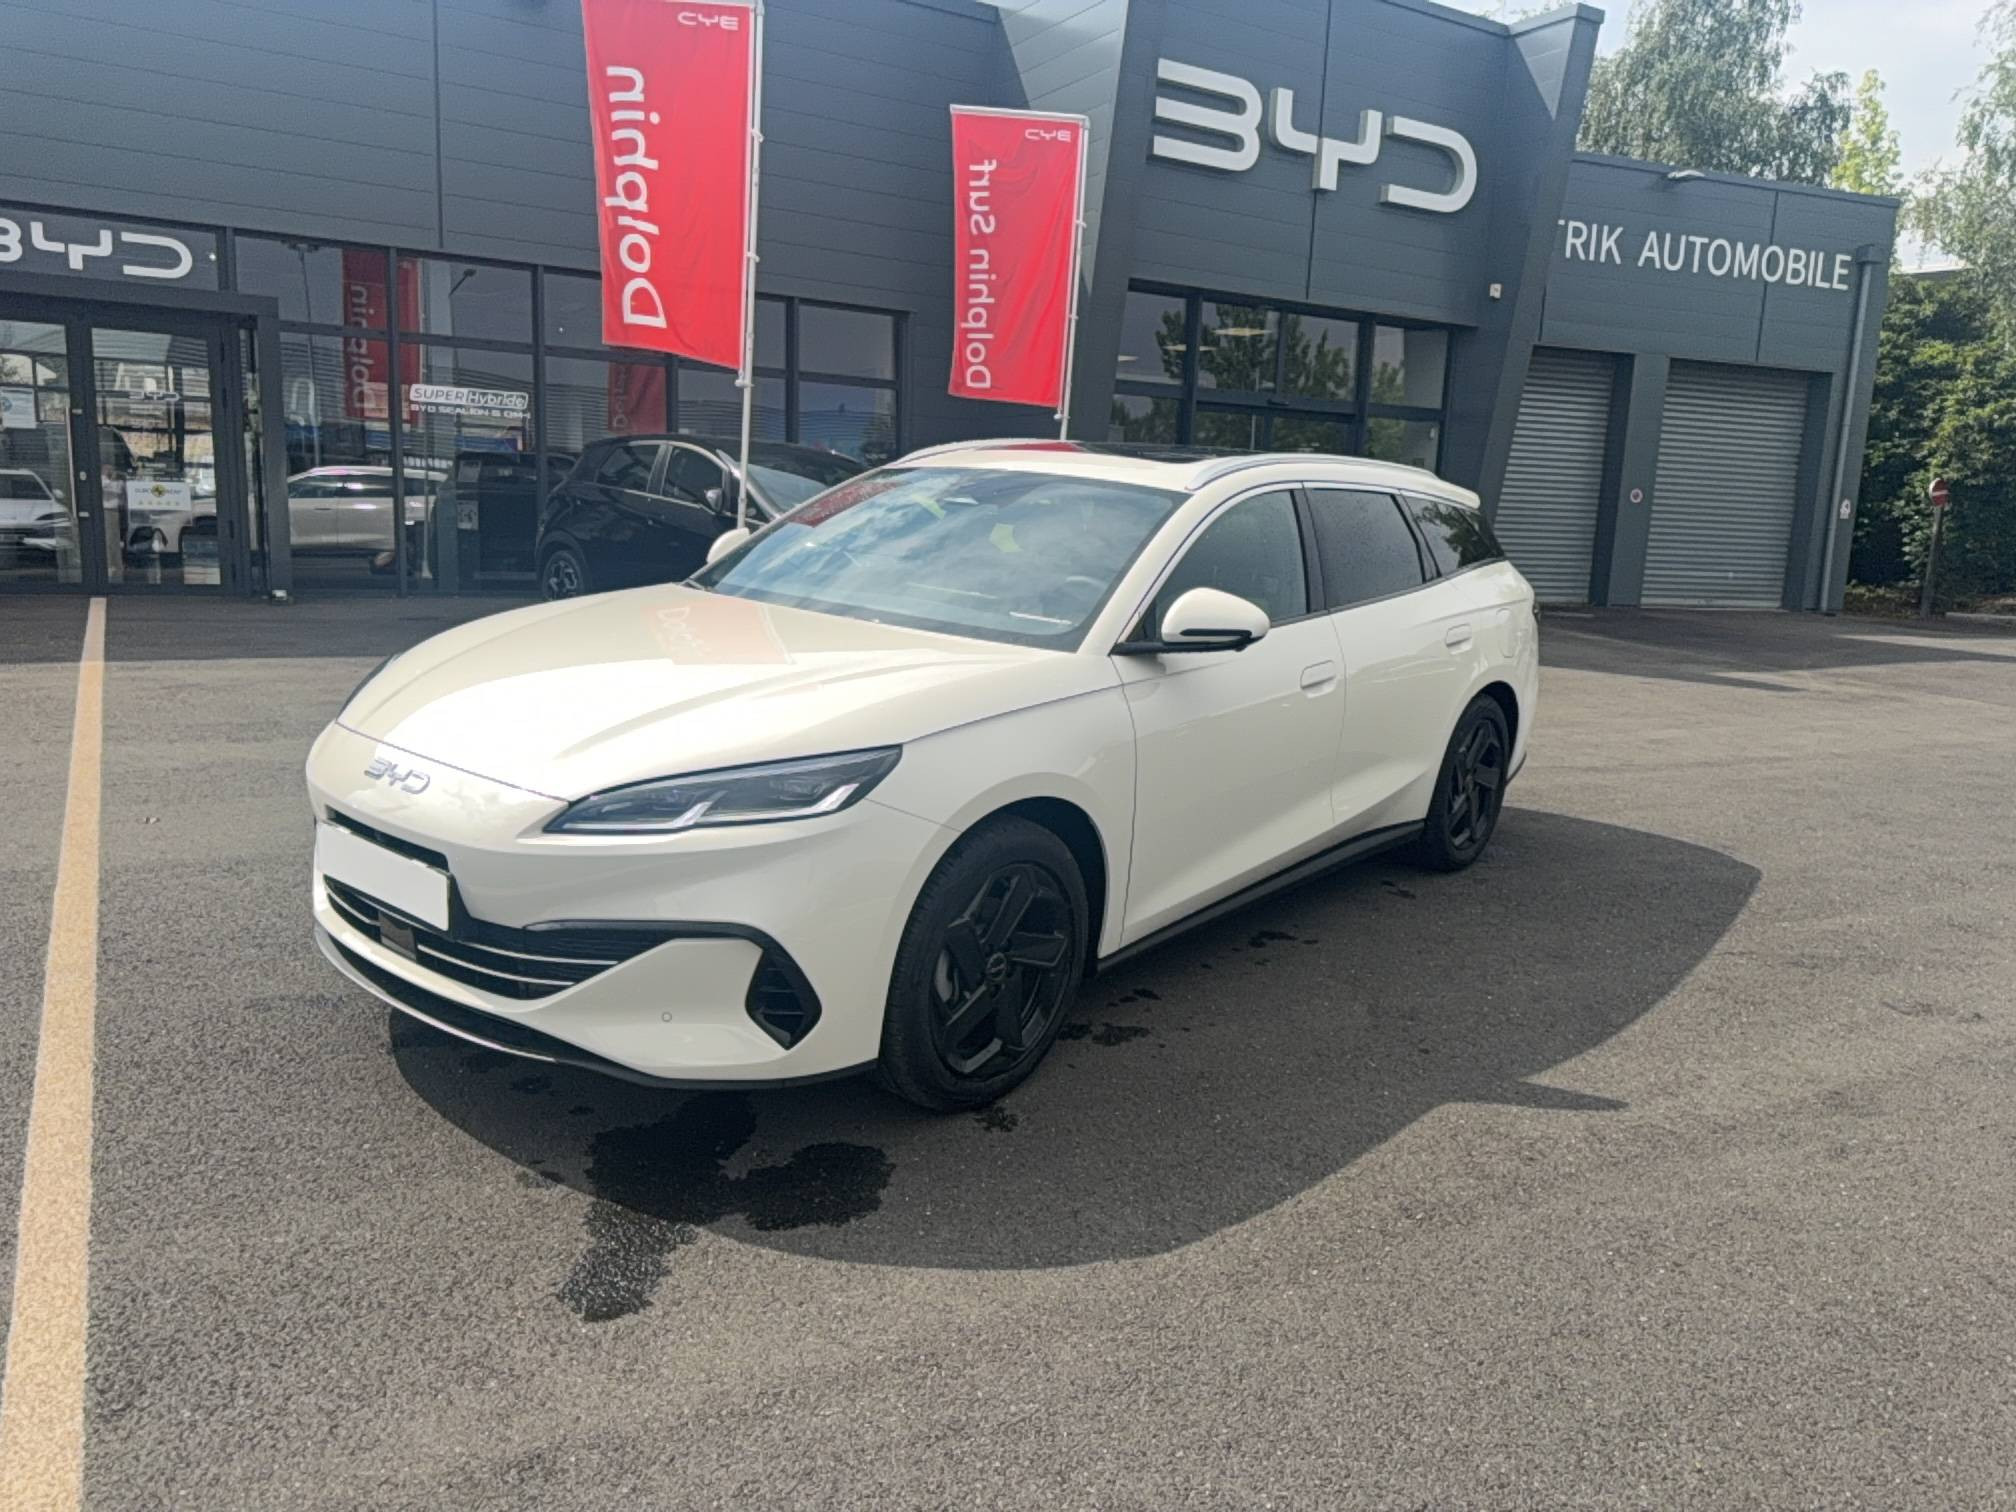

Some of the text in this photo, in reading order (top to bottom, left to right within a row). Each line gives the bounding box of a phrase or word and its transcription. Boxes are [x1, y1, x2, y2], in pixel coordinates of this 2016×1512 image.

[1151, 58, 1477, 213] BYD
[0, 217, 193, 279] YD
[1557, 219, 1853, 291] RIK AUTOMOBILE
[410, 403, 437, 413] BYD
[437, 405, 489, 417] SEALION
[413, 387, 526, 408] SUPER Hybride
[363, 757, 431, 795] BYD
